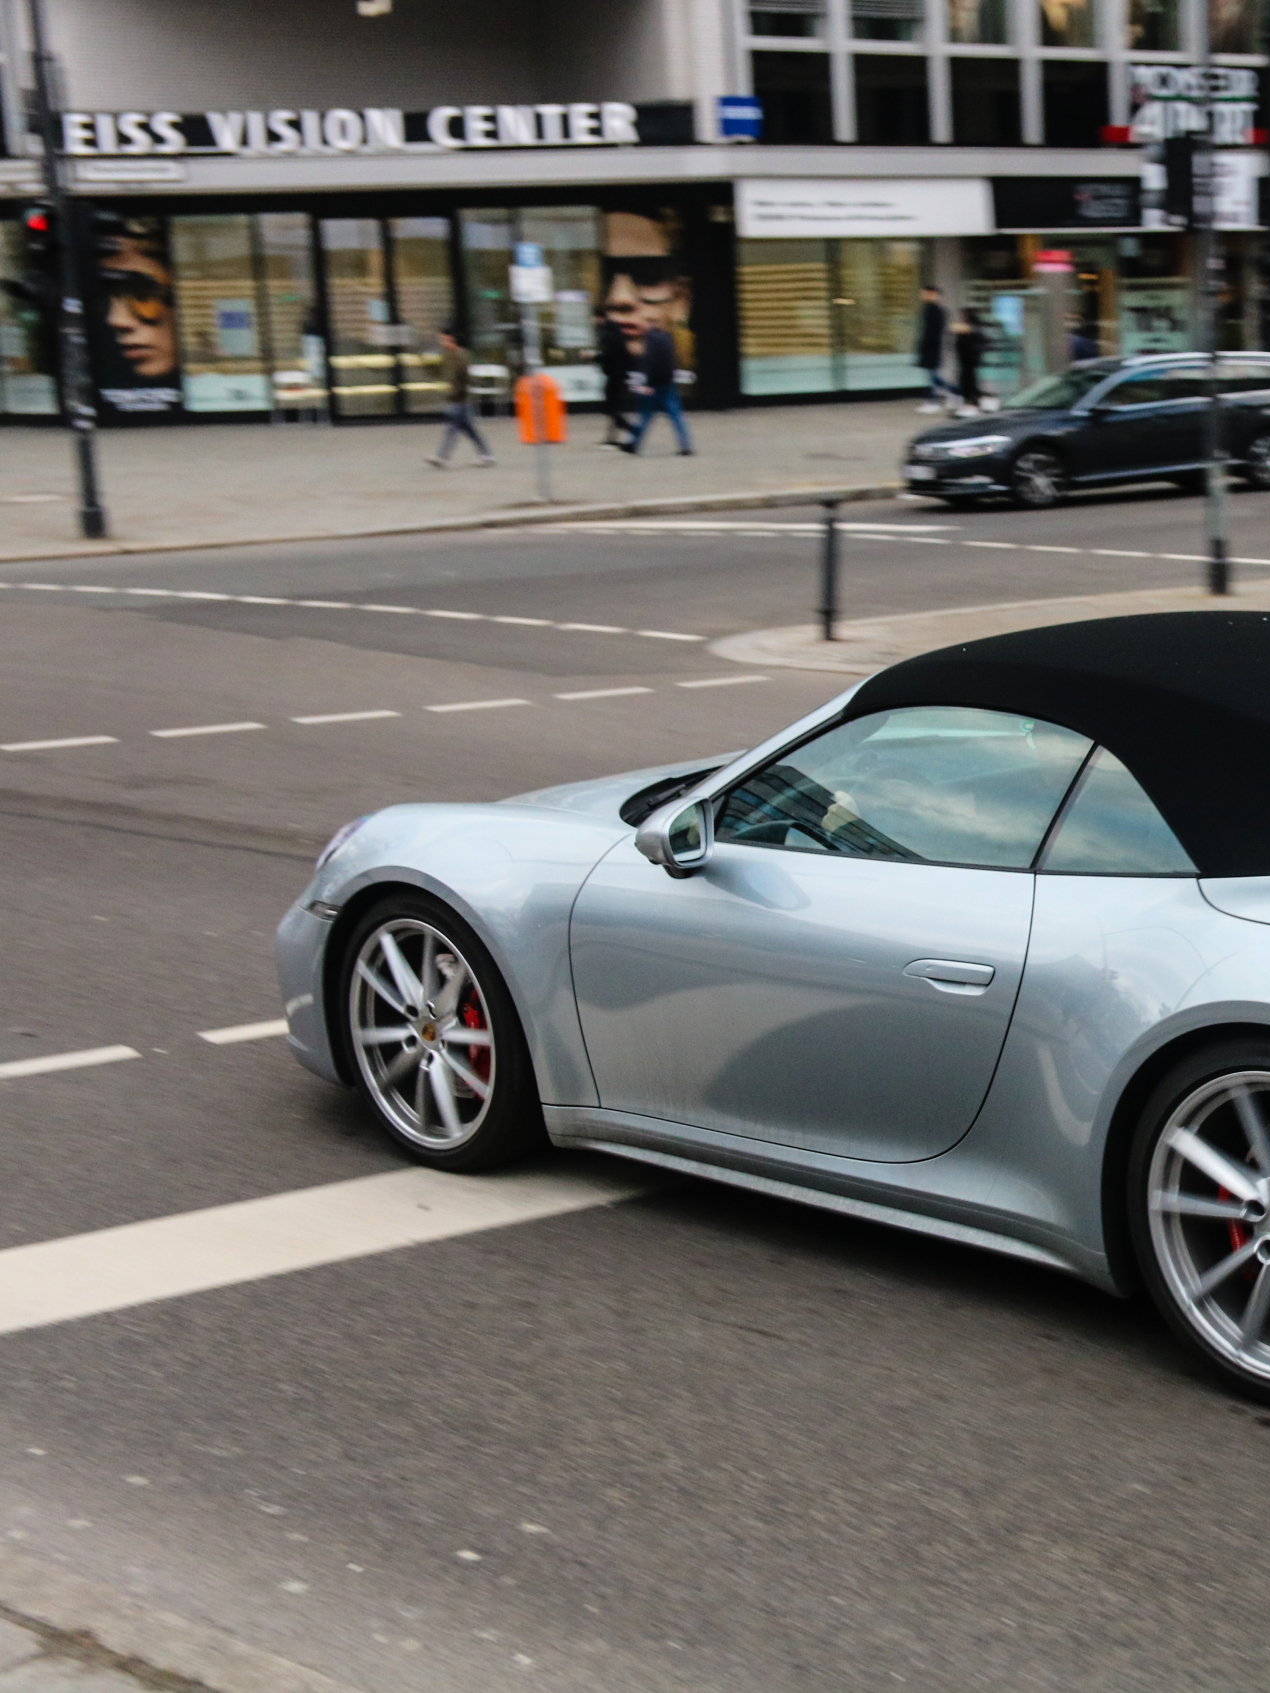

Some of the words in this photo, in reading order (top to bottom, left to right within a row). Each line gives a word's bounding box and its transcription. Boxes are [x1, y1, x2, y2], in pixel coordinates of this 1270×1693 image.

[28, 111, 188, 155] EISS
[205, 108, 406, 153] VISION
[427, 102, 640, 147] CENTER
